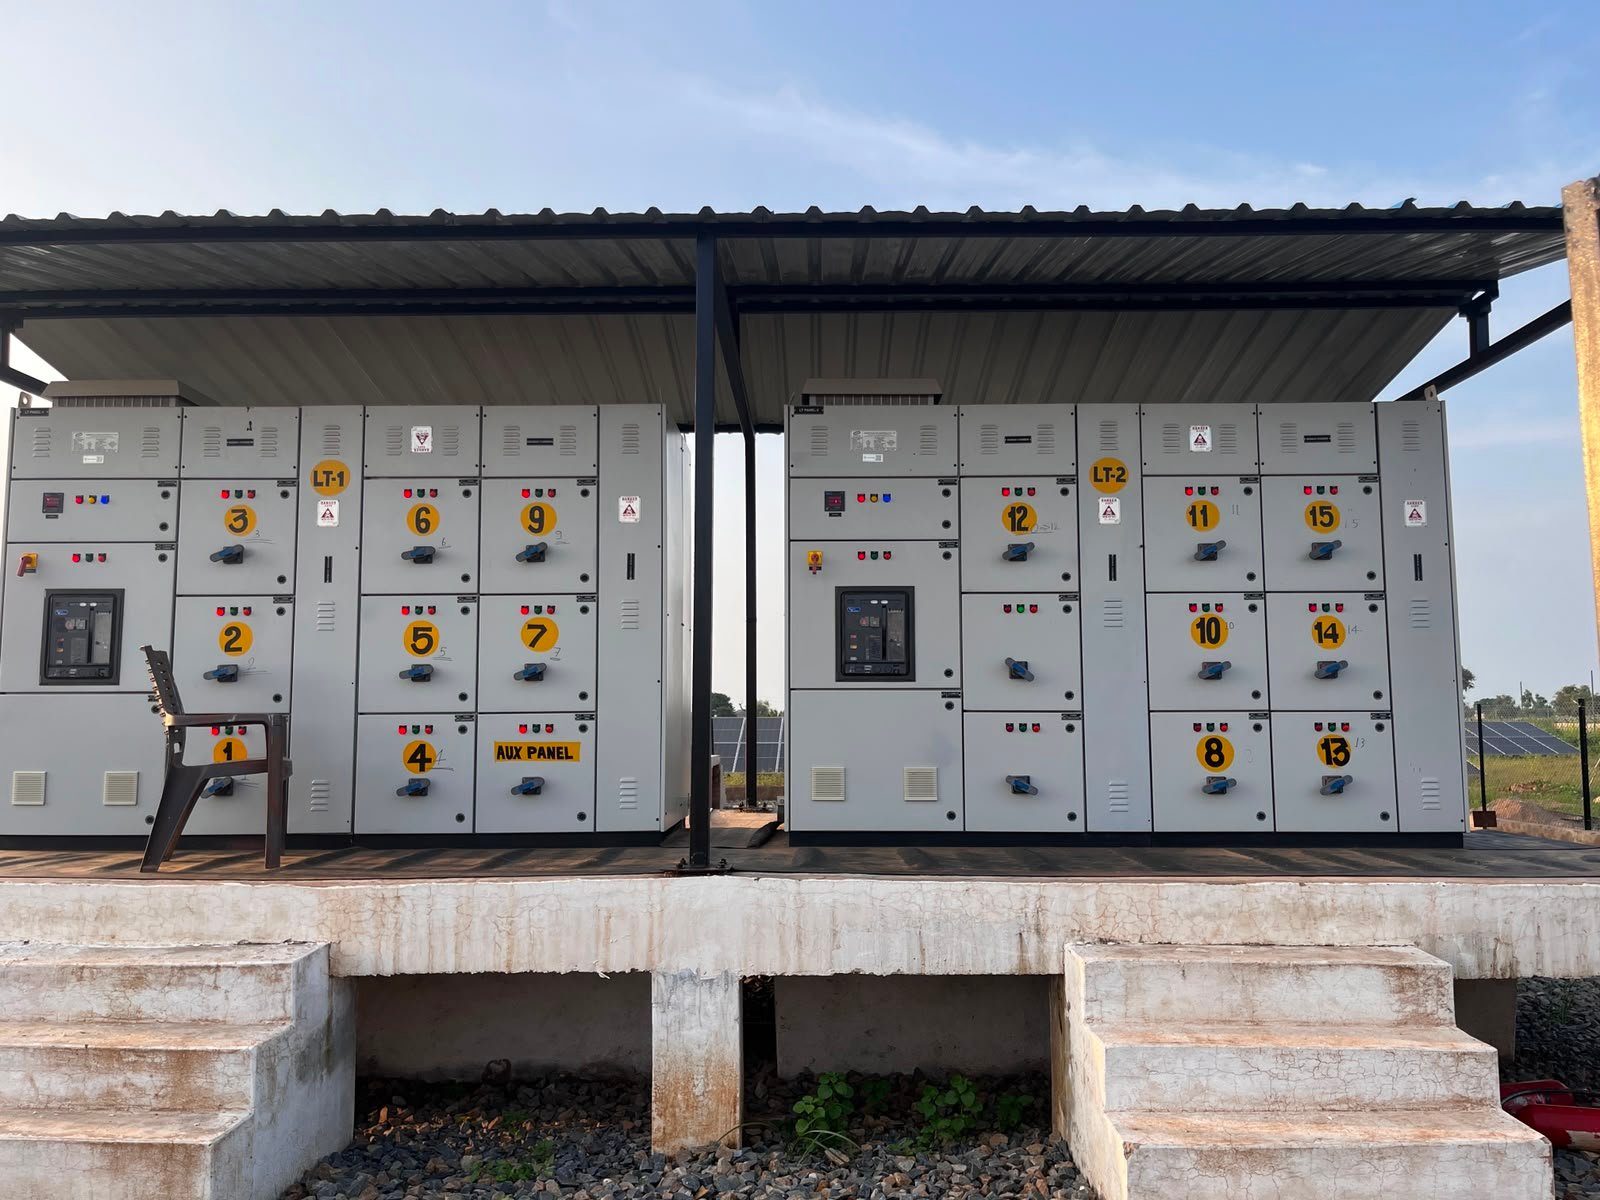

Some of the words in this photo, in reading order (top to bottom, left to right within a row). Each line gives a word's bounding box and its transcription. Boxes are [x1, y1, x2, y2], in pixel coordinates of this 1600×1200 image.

[313, 471, 345, 487] LT-1
[1094, 466, 1127, 483] LT-2
[229, 508, 249, 534] 3
[415, 506, 431, 535] 6
[527, 505, 545, 535] 9
[1007, 505, 1030, 533] 12
[1189, 505, 1209, 528] 11
[1309, 505, 1335, 528] 15
[224, 625, 243, 652] 2
[410, 627, 434, 655] 5
[527, 623, 548, 649] 7
[1195, 616, 1221, 645] 10
[1313, 622, 1340, 644] 14
[222, 742, 233, 761] 1
[406, 743, 433, 773] 4
[496, 745, 523, 761] AUX
[526, 745, 574, 761] PANEL
[1204, 737, 1225, 769] 8
[1320, 737, 1351, 768] 13
